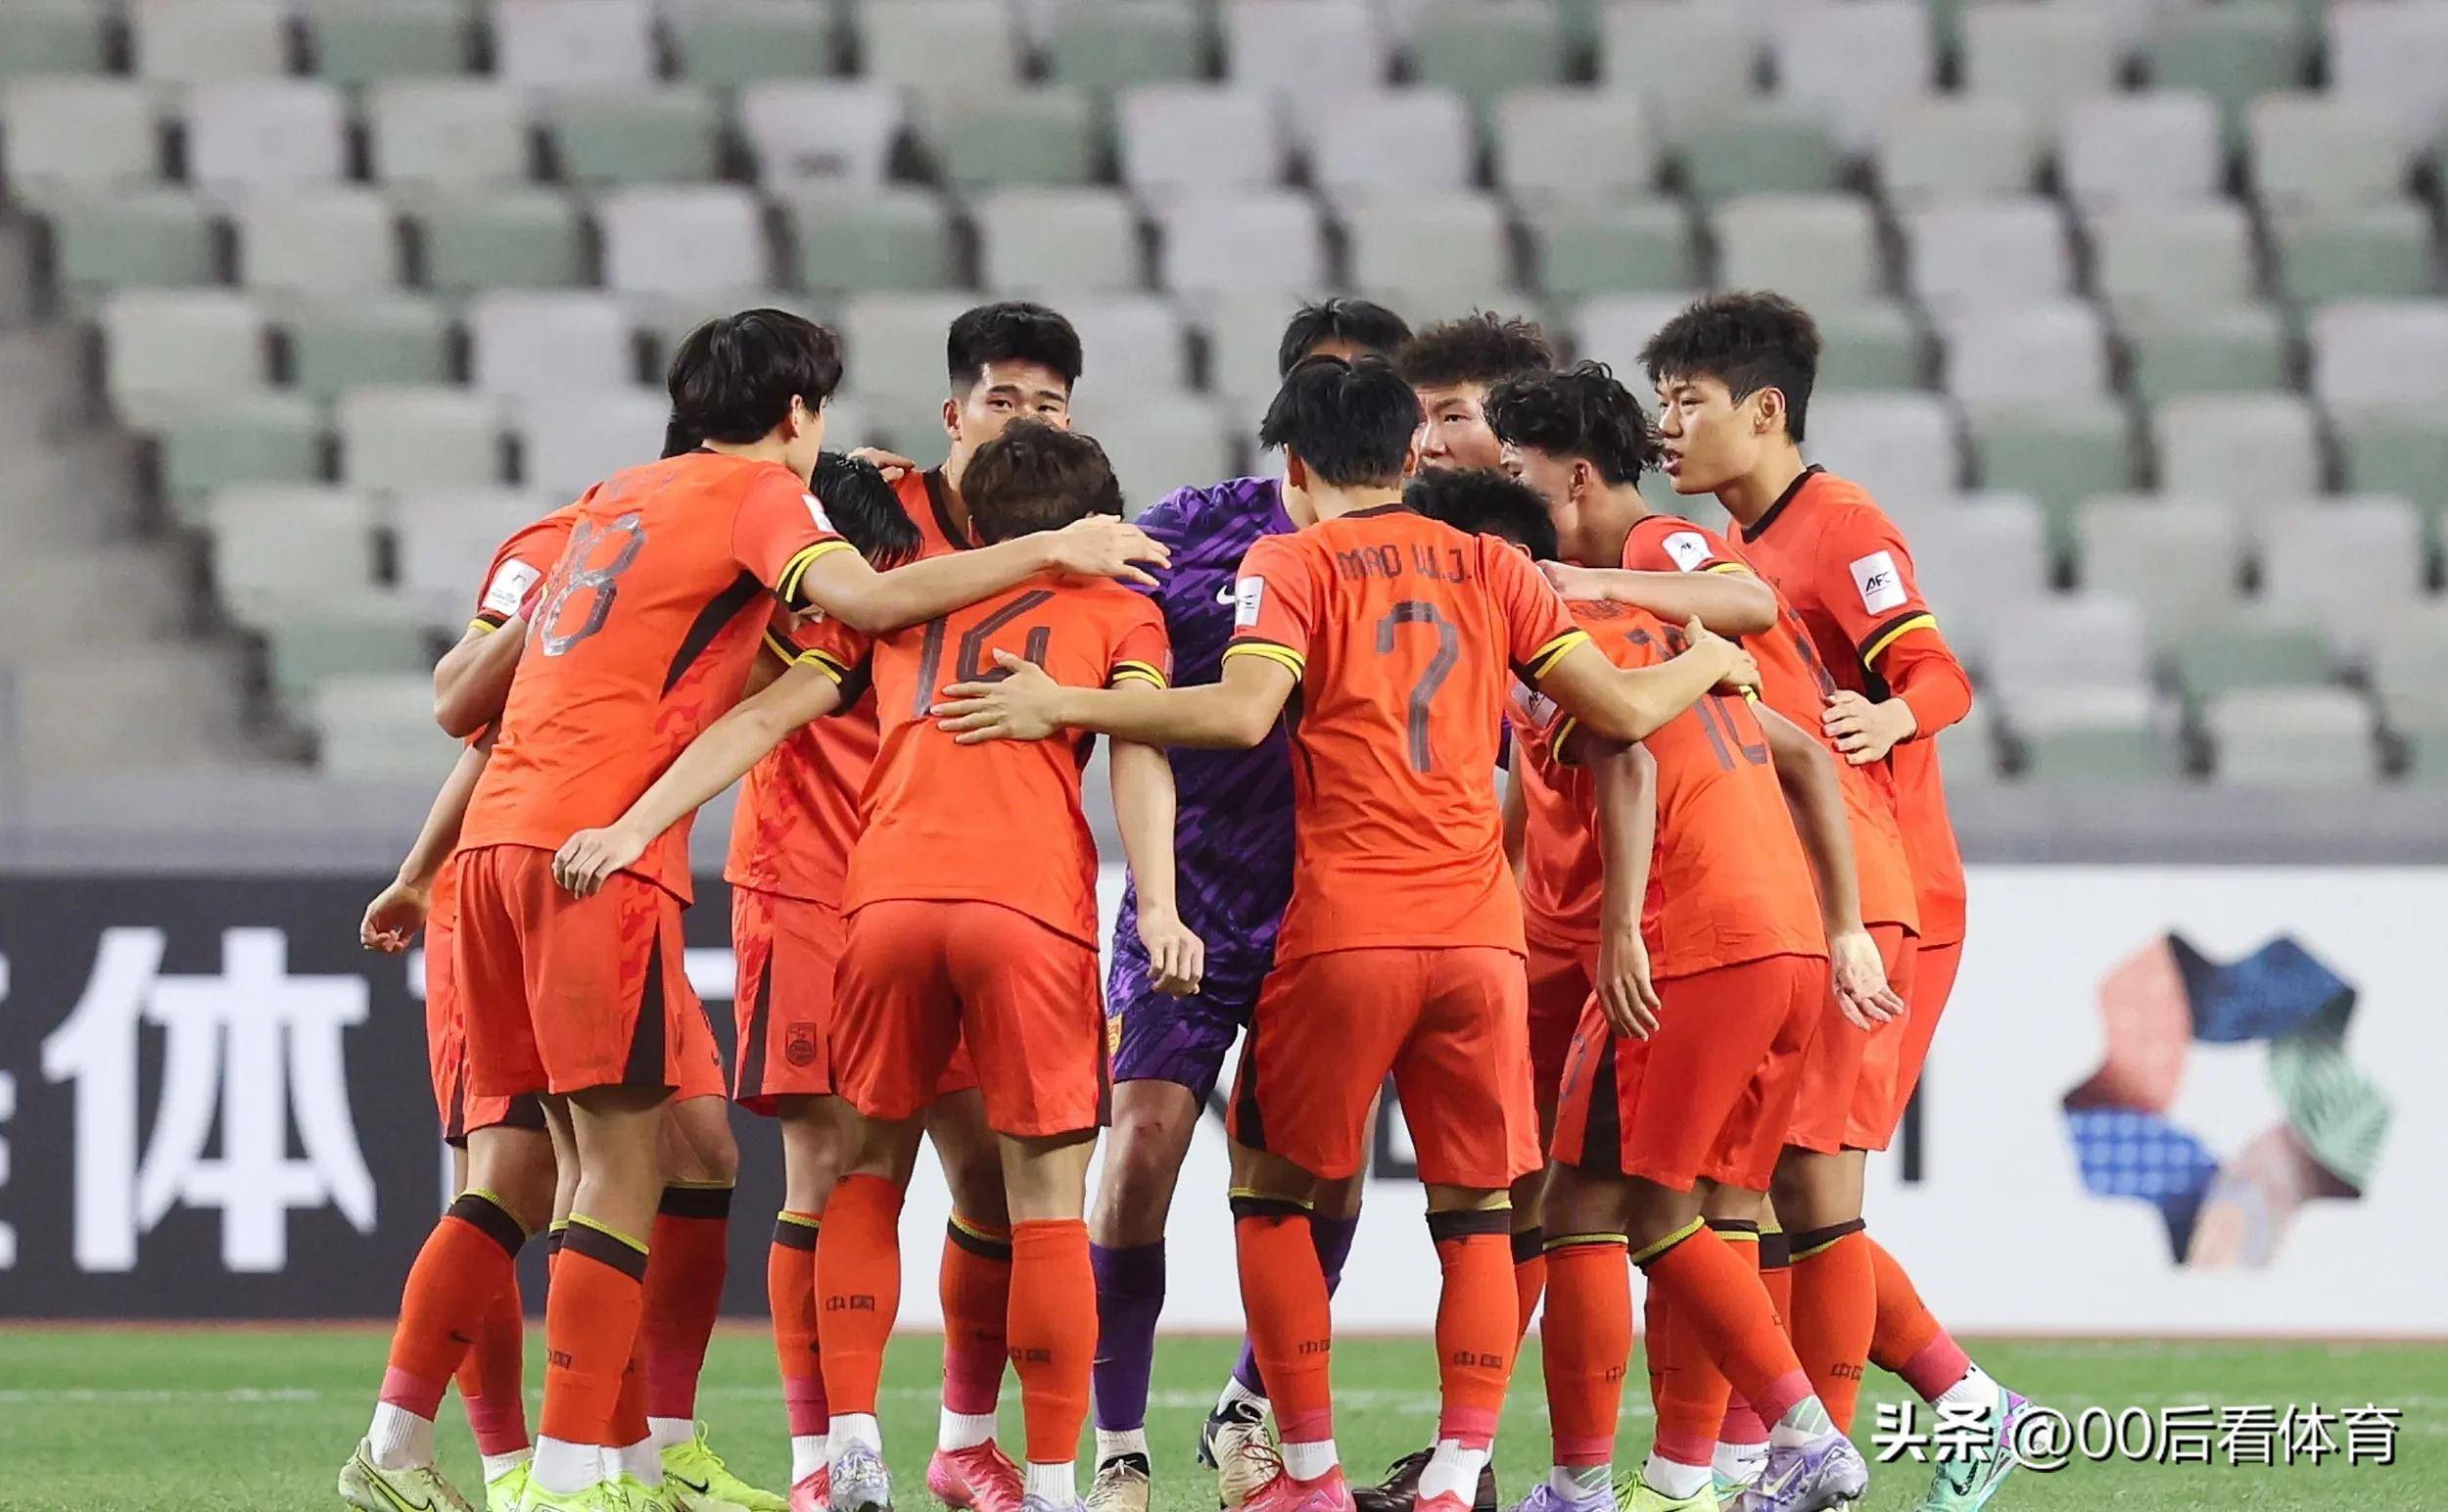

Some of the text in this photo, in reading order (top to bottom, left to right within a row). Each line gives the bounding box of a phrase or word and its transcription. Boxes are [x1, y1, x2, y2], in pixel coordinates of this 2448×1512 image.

[541, 512, 646, 657] 8
[1337, 544, 1402, 581] MAO
[1375, 600, 1459, 773] 7
